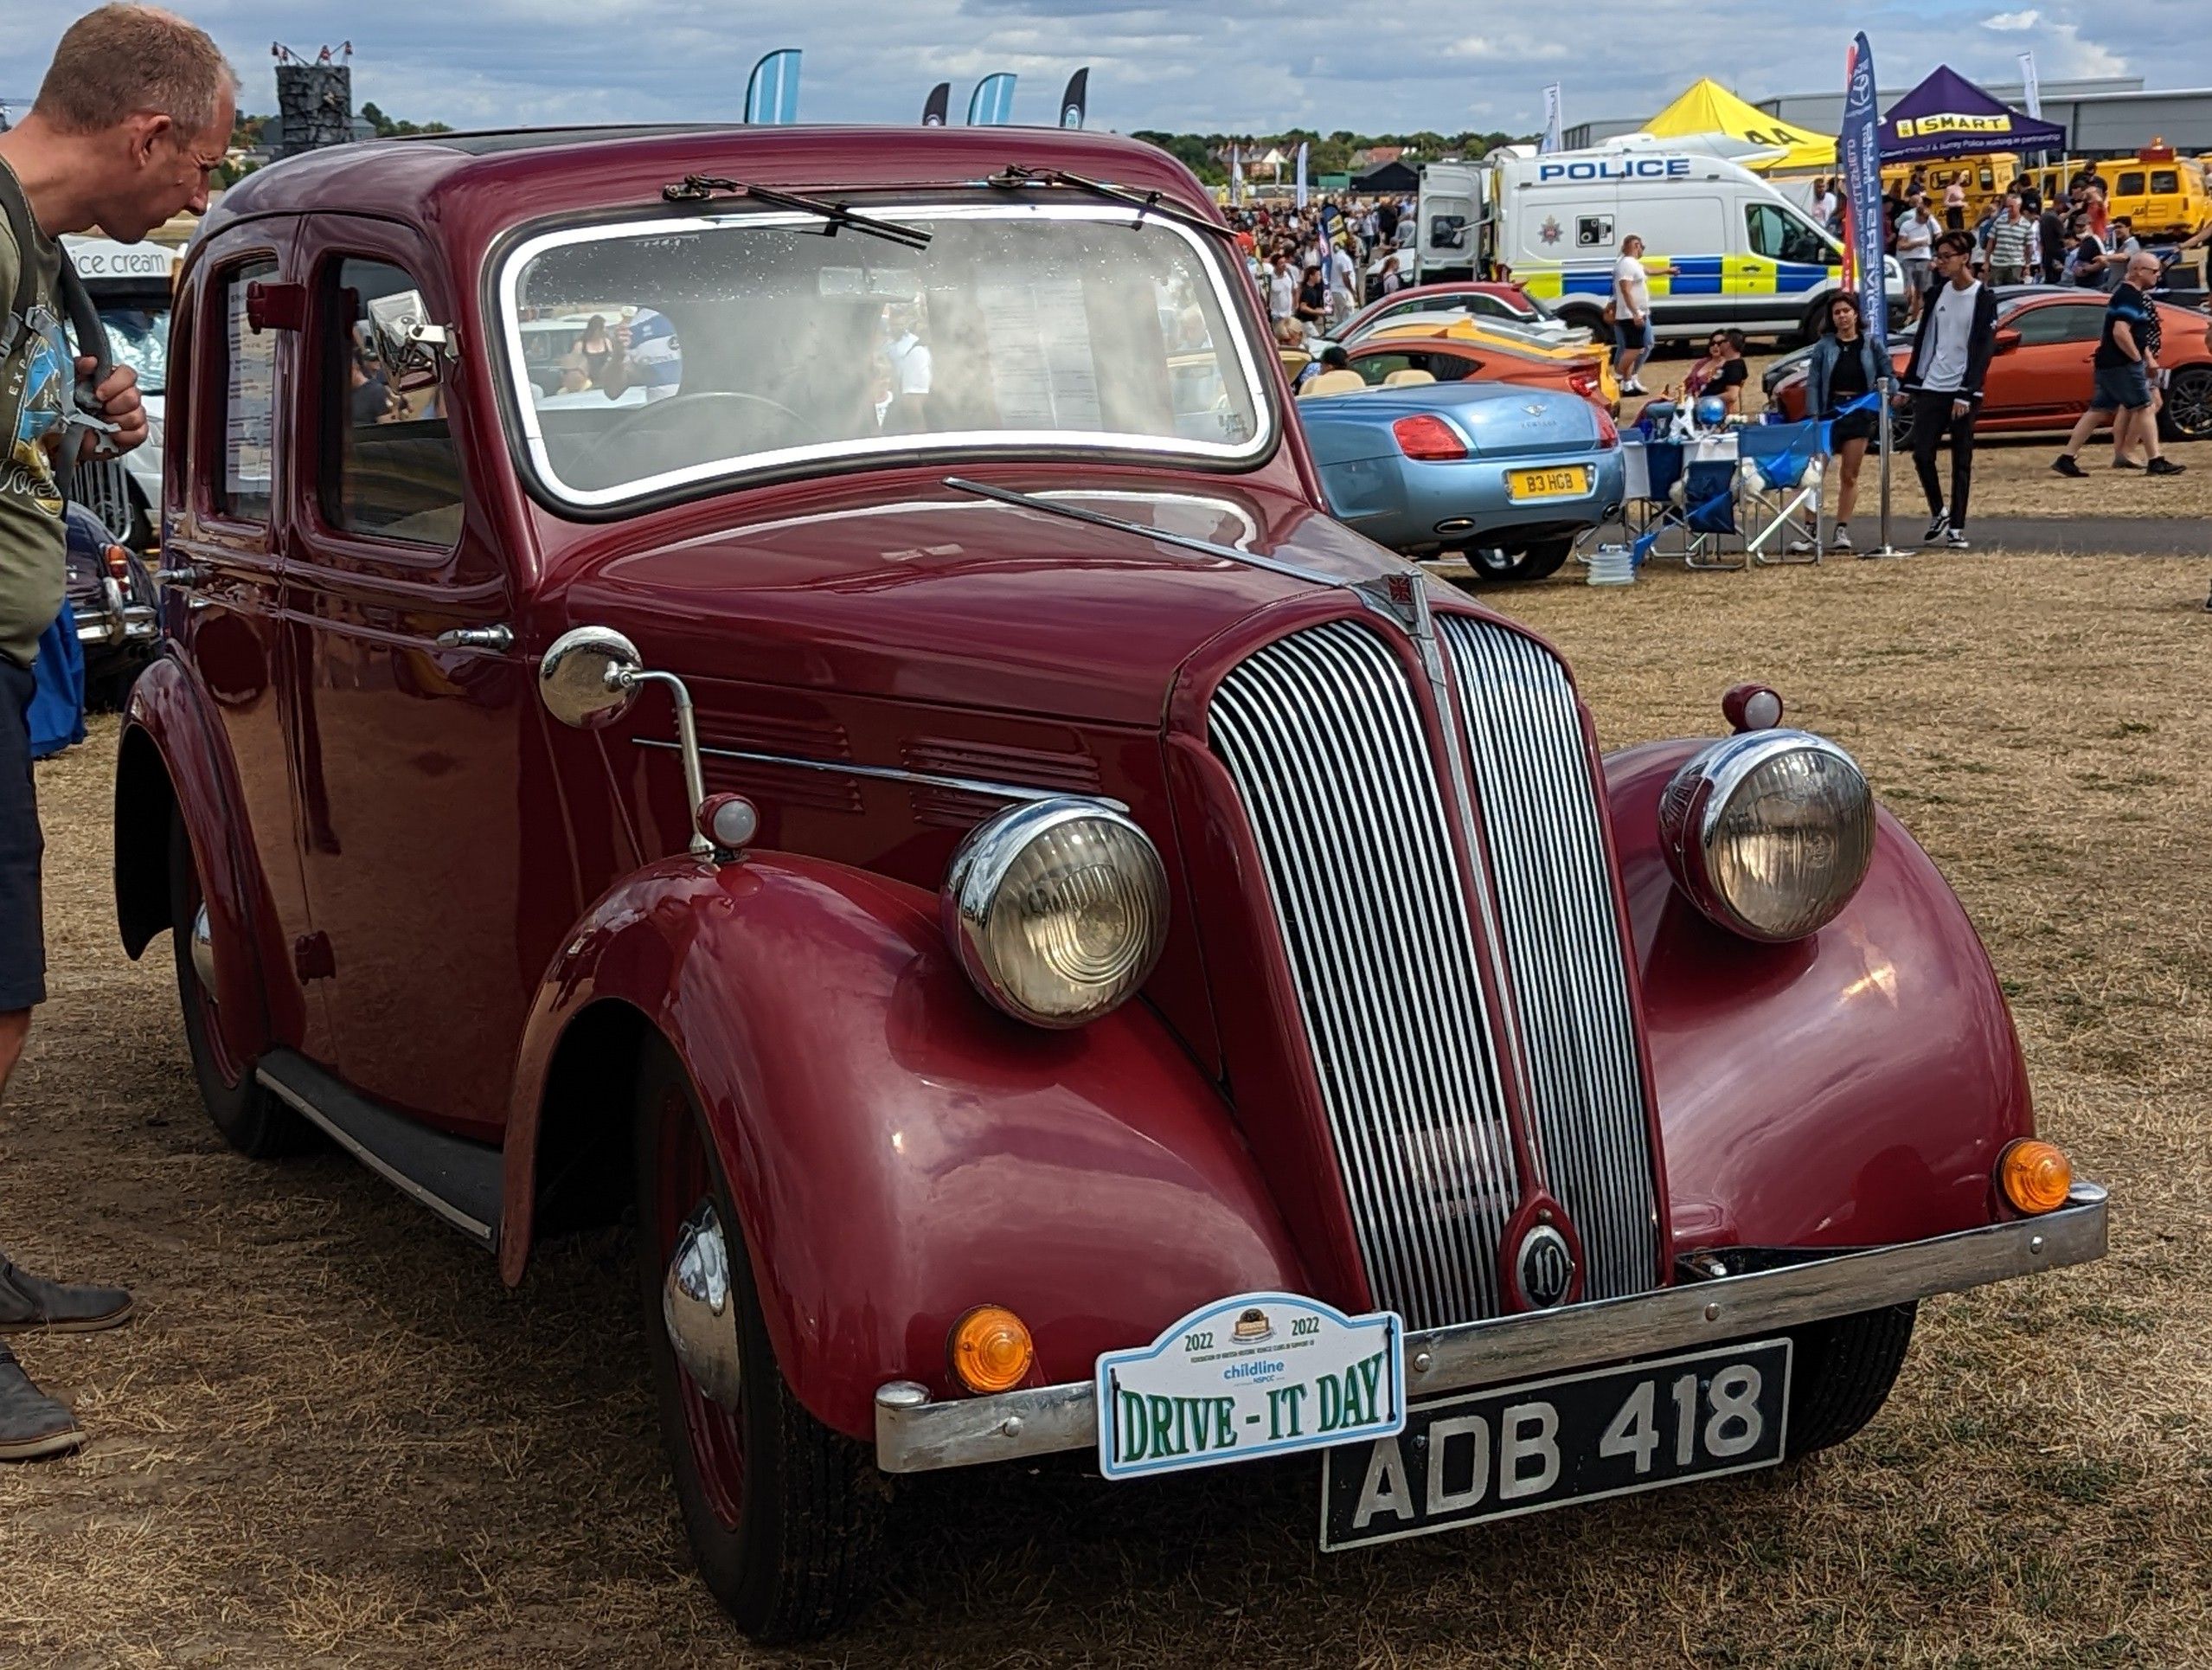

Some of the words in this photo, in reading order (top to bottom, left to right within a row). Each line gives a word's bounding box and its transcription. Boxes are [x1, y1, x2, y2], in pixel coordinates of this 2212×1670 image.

[1924, 118, 2002, 131] SMART
[1743, 128, 1809, 145] AA
[1540, 157, 1690, 181] POLICE
[72, 250, 106, 273] ice
[111, 254, 166, 273] cream
[1526, 476, 1546, 492] B3
[1534, 1246, 1563, 1296] 10
[1185, 1332, 1214, 1352] 2022
[1292, 1316, 1320, 1336] 2022
[1223, 1360, 1285, 1380] childline
[1253, 1375, 1275, 1384] NSPCC
[1121, 1389, 1238, 1463] DRIVE
[1266, 1384, 1307, 1441] IT
[1316, 1352, 1384, 1434] DAY
[1352, 1401, 1560, 1529] ADB
[1599, 1364, 1763, 1473] 418
